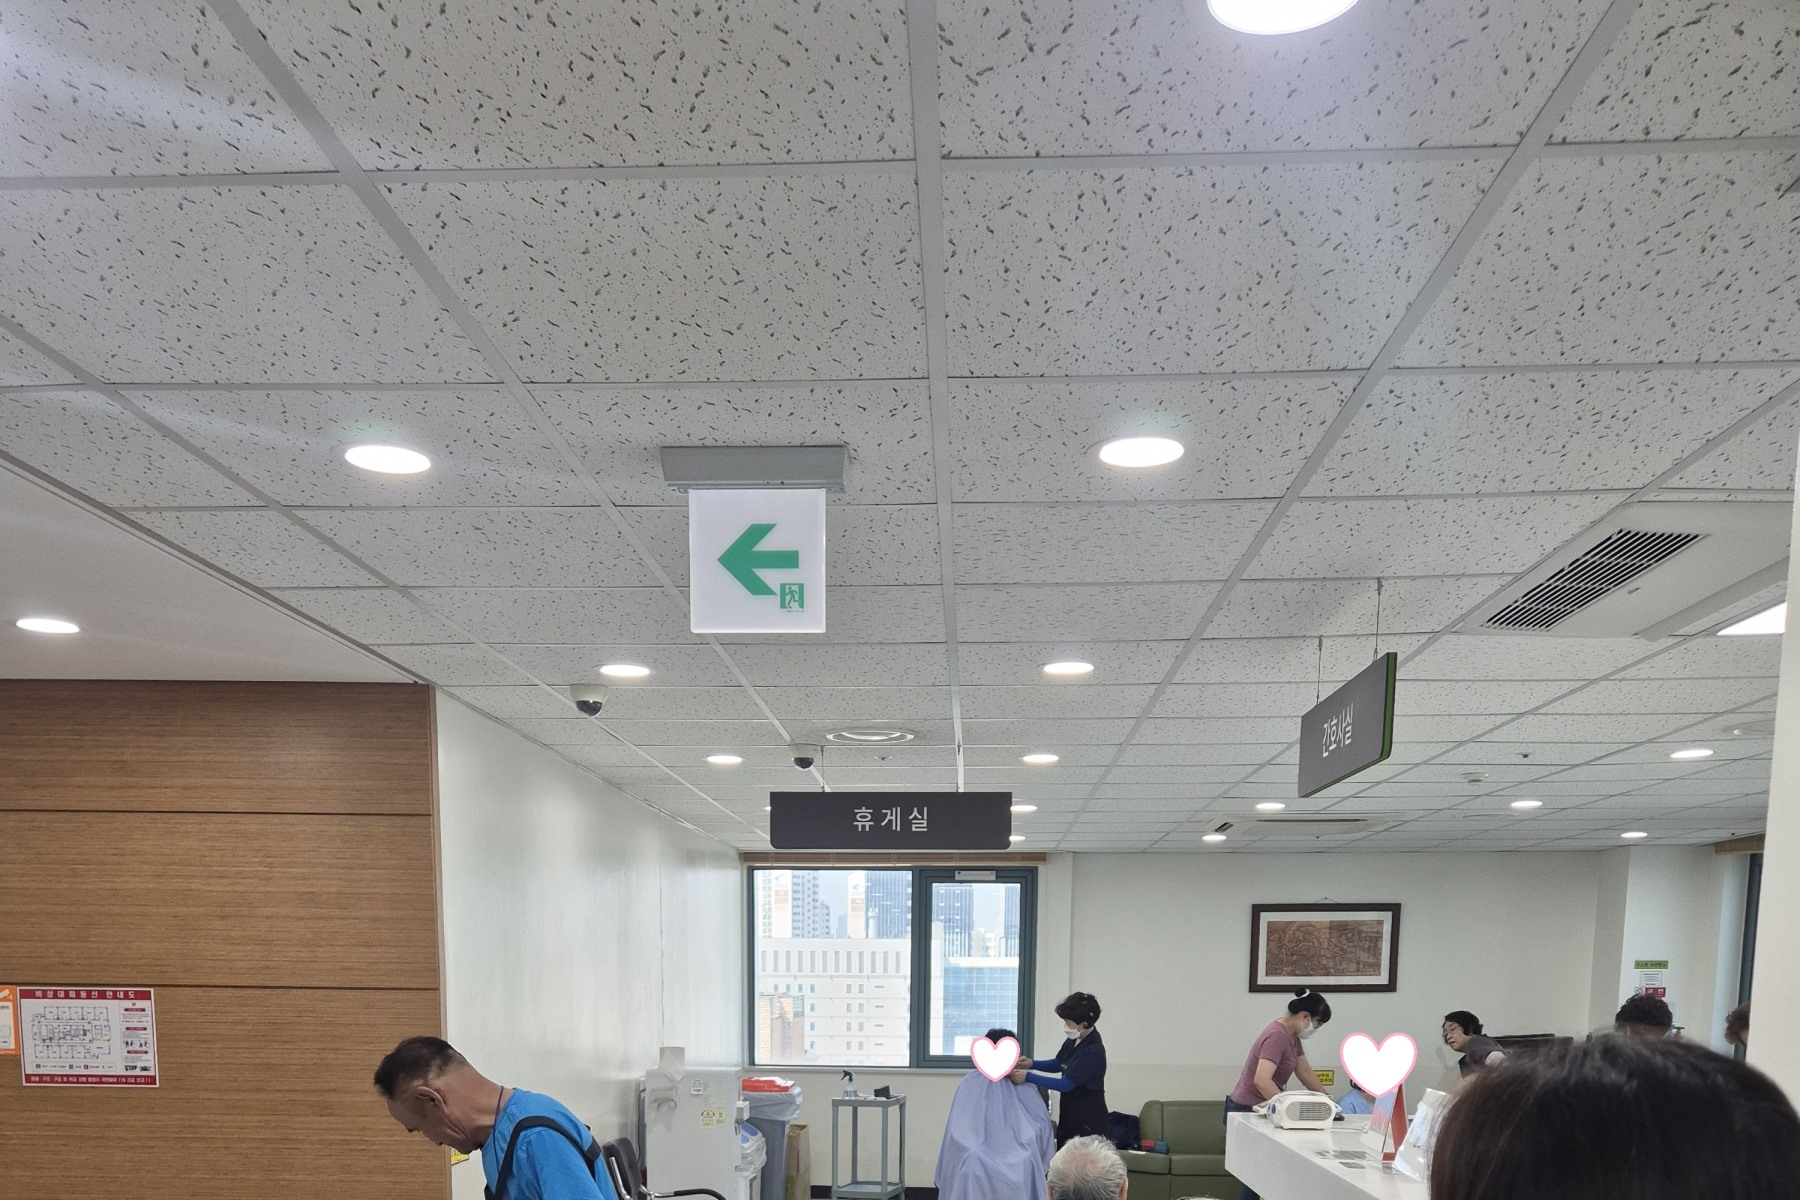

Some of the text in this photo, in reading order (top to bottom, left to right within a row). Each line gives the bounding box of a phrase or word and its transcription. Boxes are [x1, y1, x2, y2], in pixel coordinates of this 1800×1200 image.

[1322, 702, 1353, 758] 간호사실
[853, 806, 929, 832] 휴게실
[106, 990, 136, 999] 안내도
